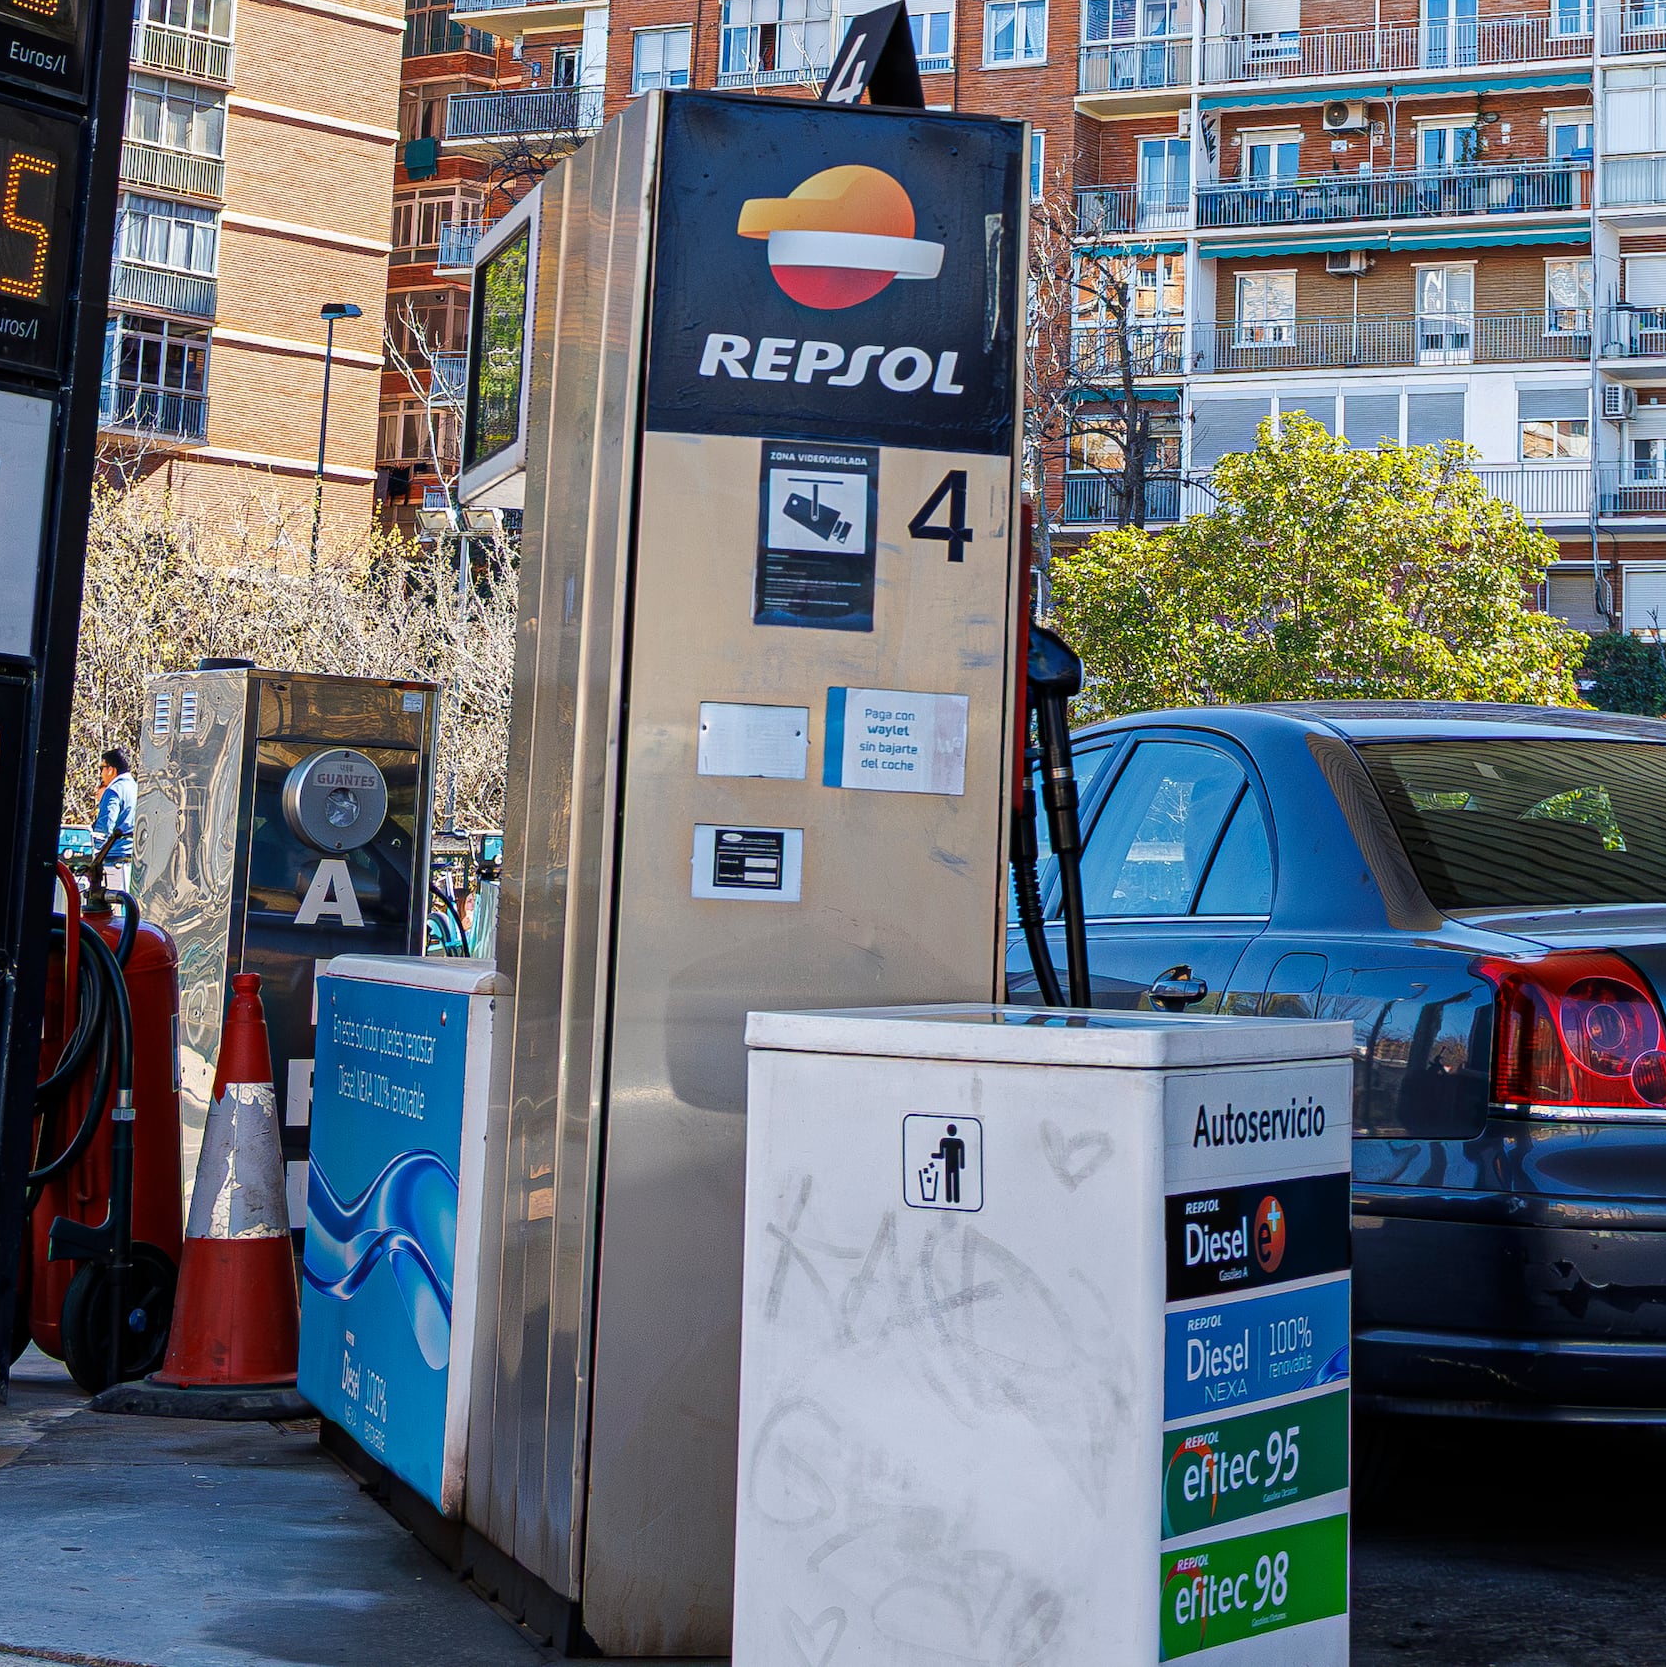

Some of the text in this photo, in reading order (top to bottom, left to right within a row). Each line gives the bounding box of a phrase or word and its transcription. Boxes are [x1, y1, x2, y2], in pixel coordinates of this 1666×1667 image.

[9, 41, 66, 75] Euros/l
[826, 33, 866, 104] 4
[699, 333, 965, 395] REPSOL
[770, 451, 868, 466] ZONA VIDEOVIGILADA
[907, 470, 974, 563] 4
[865, 708, 915, 722] Paga con
[867, 725, 910, 737] waylet
[859, 741, 918, 755] sin bajarte
[861, 758, 915, 771] del coche
[317, 774, 375, 787] GUANTES
[1194, 1097, 1325, 1148] Autoservicio
[1185, 1199, 1220, 1215] REPSOL
[1186, 1216, 1248, 1265] Diesel
[1188, 1315, 1222, 1331] REPSOL
[1187, 1316, 1313, 1381] Diesel 100%
[1269, 1352, 1313, 1379] renovable
[1204, 1378, 1248, 1405] NEXA
[1185, 1431, 1219, 1449] REPSOL
[1184, 1426, 1300, 1502] efitec 95
[1176, 1553, 1209, 1572] REPSOL
[1175, 1550, 1289, 1625] efitec 98
